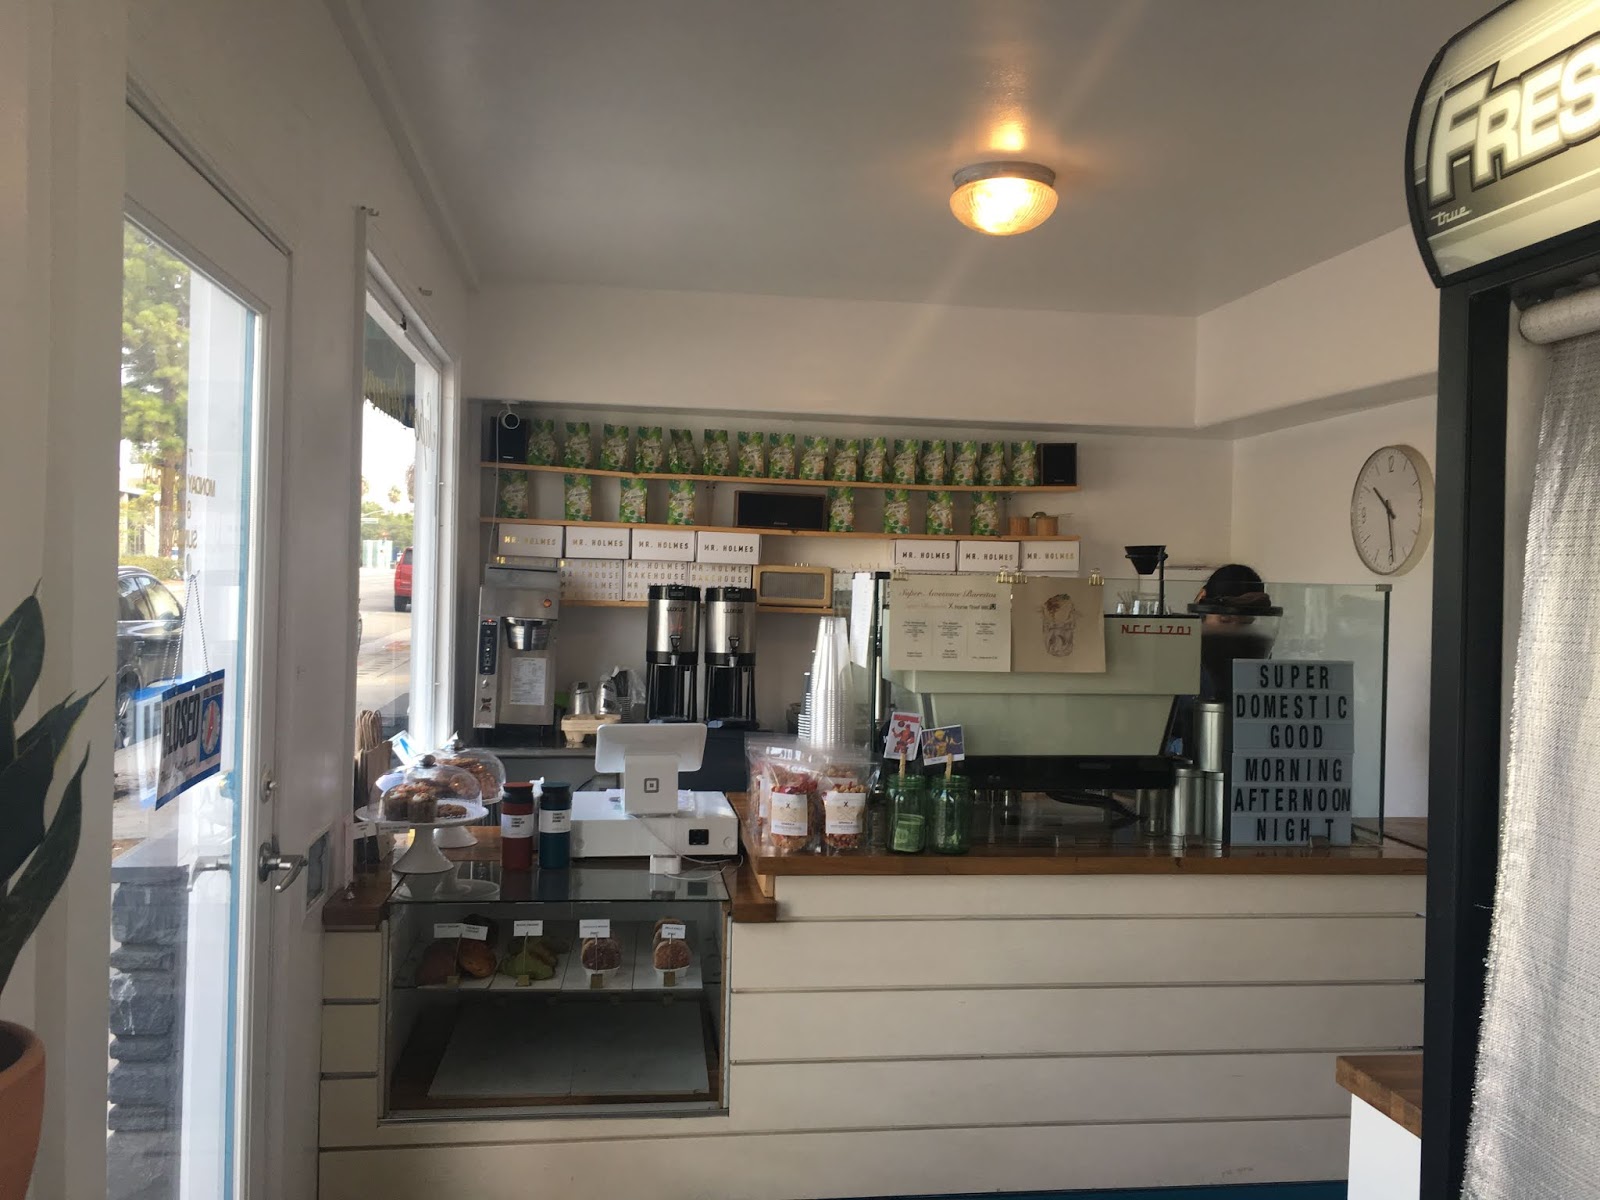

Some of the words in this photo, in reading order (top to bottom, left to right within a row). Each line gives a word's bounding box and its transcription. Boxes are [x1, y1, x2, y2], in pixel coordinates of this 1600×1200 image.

[1431, 204, 1472, 227] true
[591, 539, 623, 547] HOLMES
[638, 540, 653, 549] MR.
[657, 541, 689, 550] HOLMES
[704, 544, 718, 552] MR.
[723, 544, 754, 553] HOLMES
[920, 552, 950, 560] HOLMES
[965, 552, 980, 560] MR.
[983, 553, 1013, 561] HOLMES
[1045, 552, 1075, 560] HOLMES
[647, 561, 686, 570] HOLMES
[712, 564, 749, 573] HOLMES
[627, 571, 685, 580] BAKEHOUSE
[691, 574, 748, 583] BAKEHOUSE
[1259, 664, 1329, 689] SUPER
[1236, 695, 1348, 719] DOMESTIC
[1270, 725, 1323, 748] GOOD
[1245, 758, 1343, 782] MORNING
[1234, 787, 1351, 812] AFTERNOON
